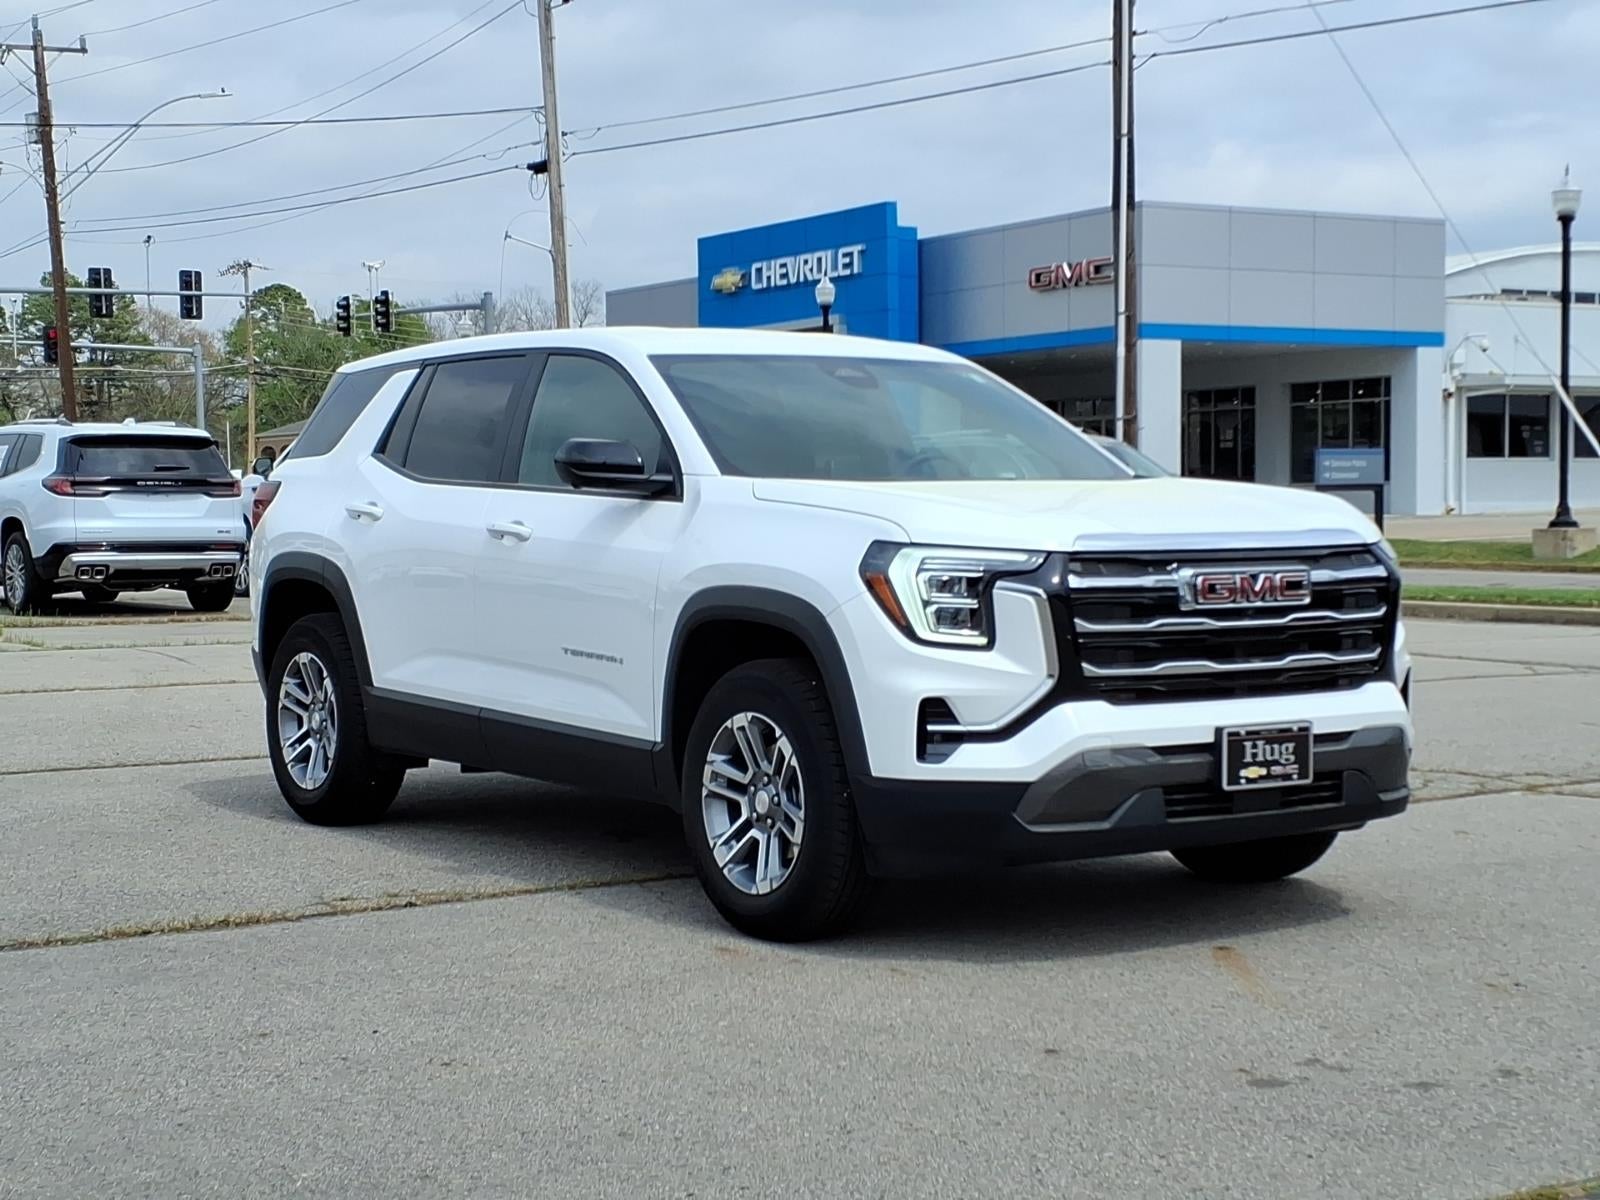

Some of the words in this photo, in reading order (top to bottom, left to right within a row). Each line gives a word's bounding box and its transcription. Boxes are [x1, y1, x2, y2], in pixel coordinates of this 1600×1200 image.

[751, 243, 866, 290] CHEVROLET
[1027, 256, 1115, 291] GMC
[1196, 572, 1309, 603] GMC
[1241, 740, 1296, 764] Hug
